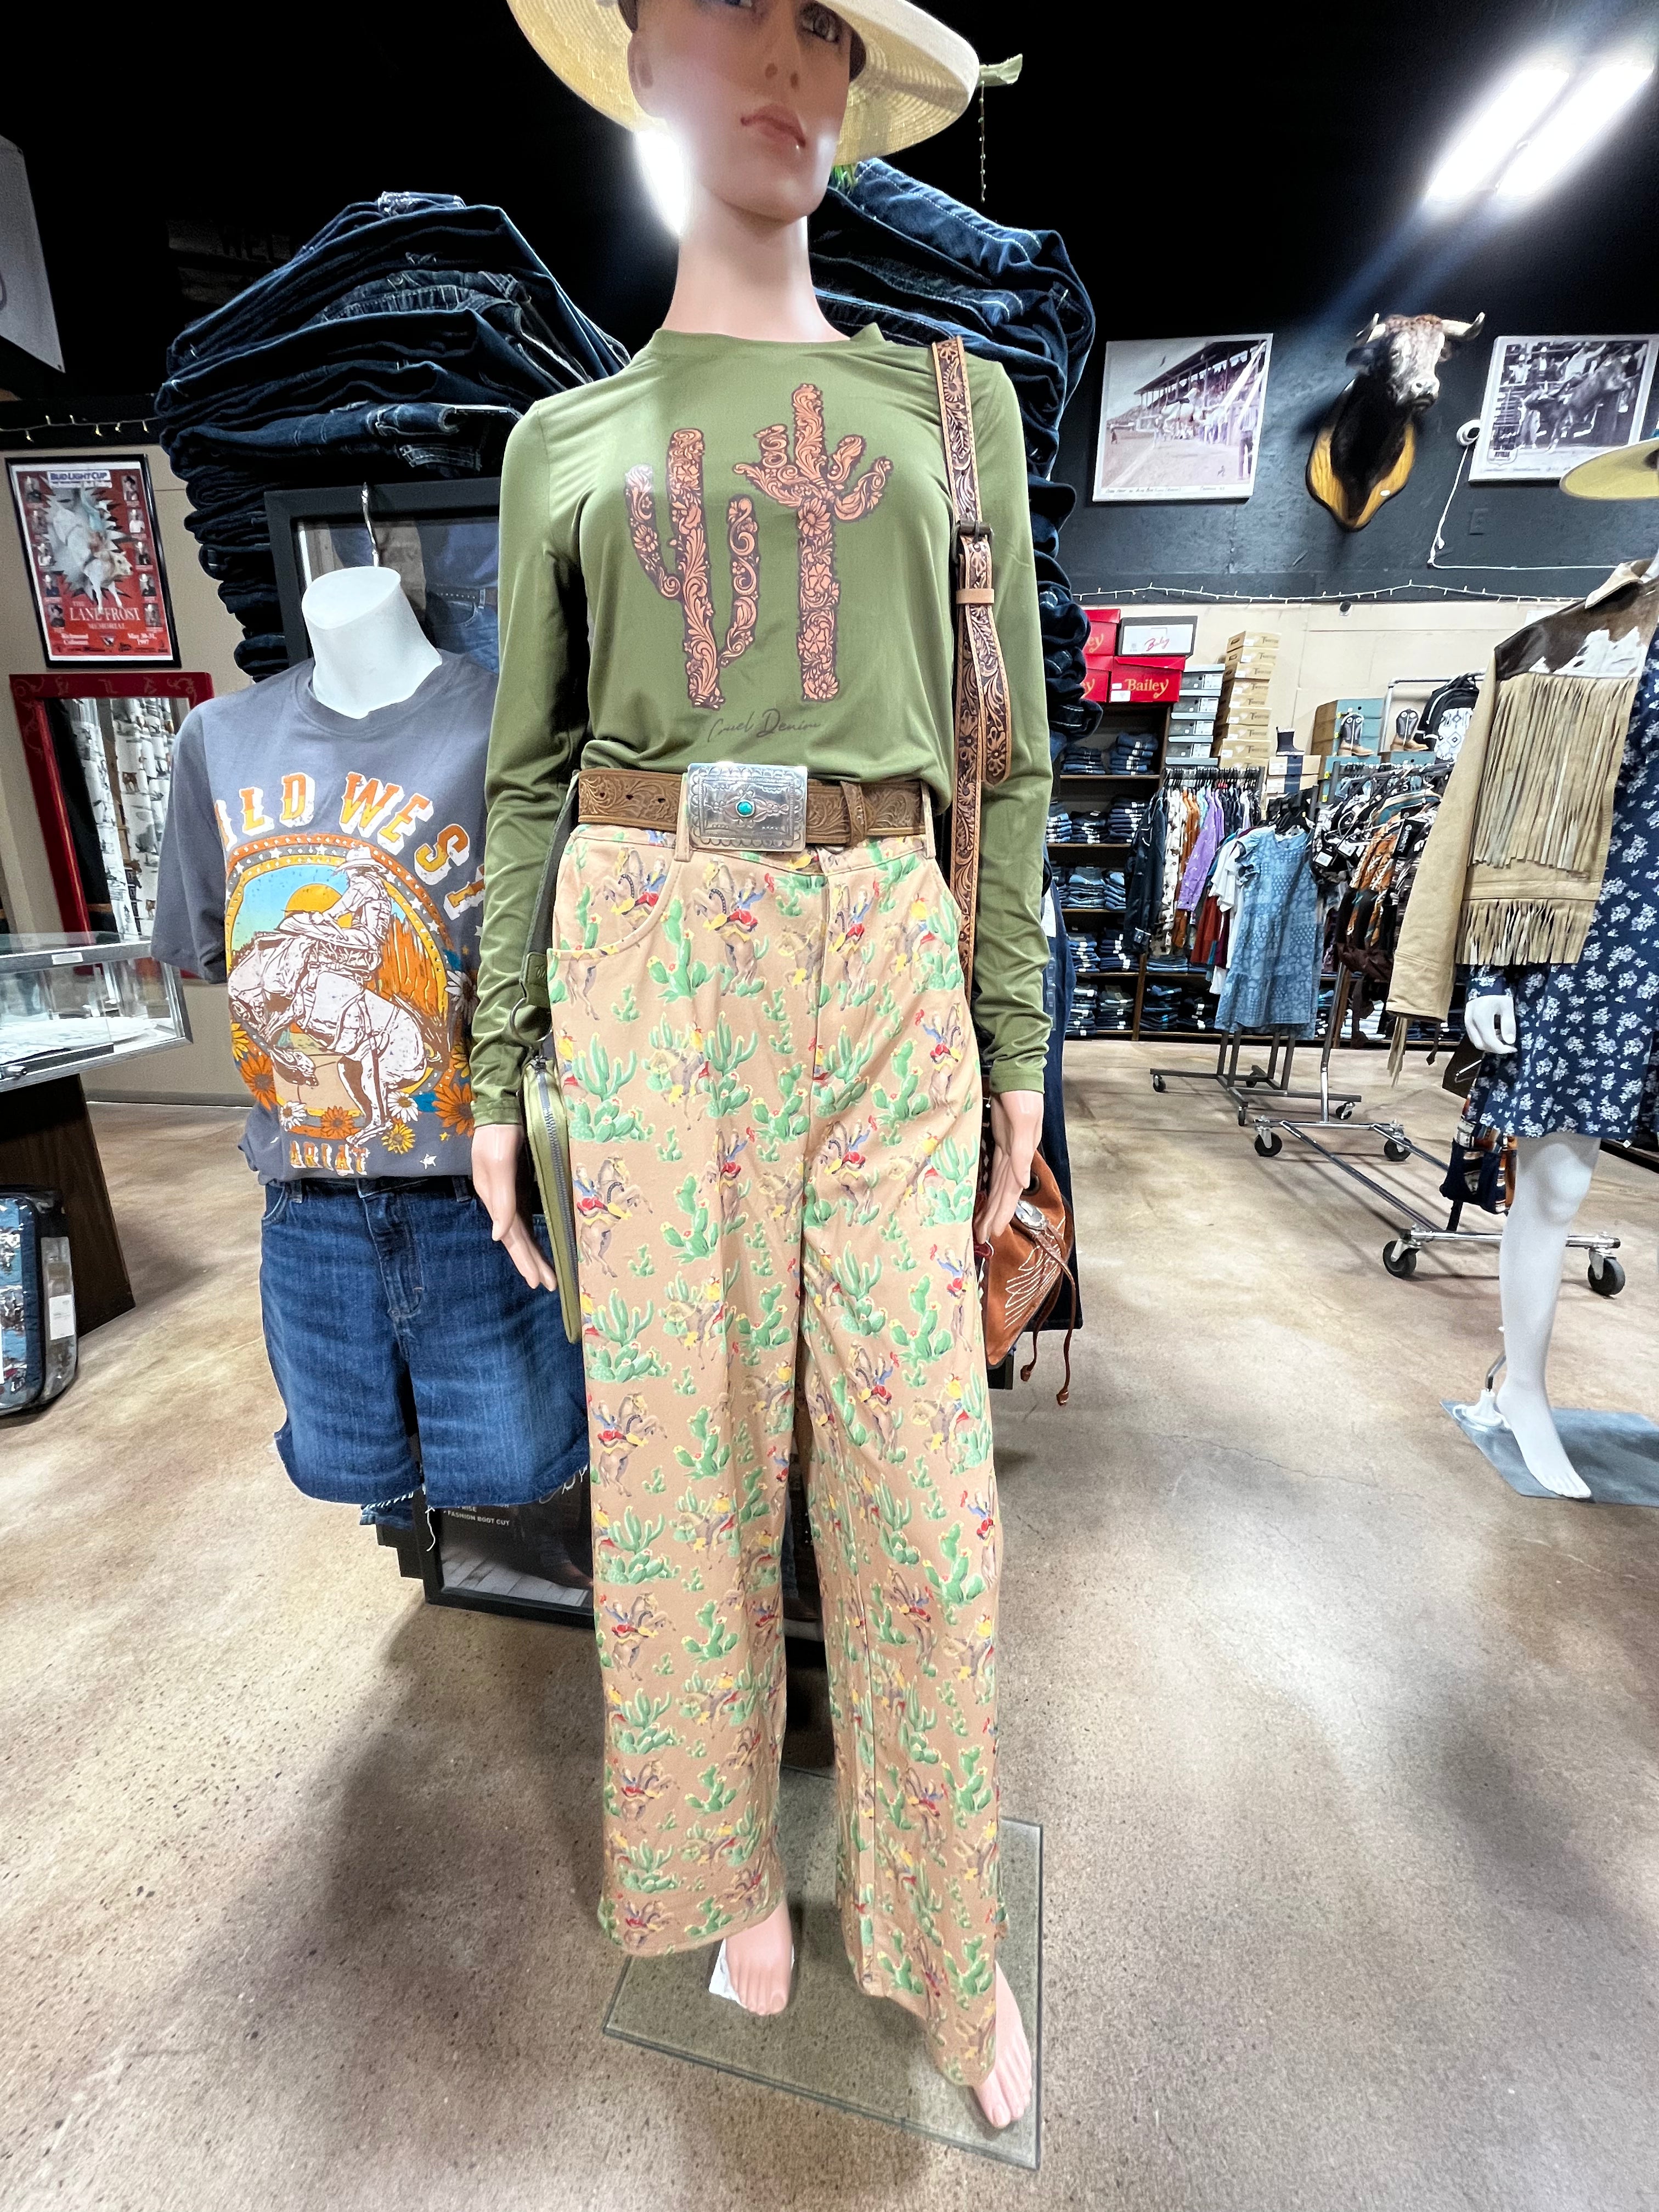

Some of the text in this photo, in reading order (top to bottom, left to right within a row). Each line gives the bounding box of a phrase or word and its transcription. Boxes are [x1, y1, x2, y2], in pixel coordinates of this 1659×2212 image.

[69, 607, 141, 621] LANE FROST
[1125, 678, 1169, 699] Bailey
[756, 708, 821, 738] Denim
[215, 772, 317, 851] LD
[289, 1141, 371, 1177] ARIAT
[448, 1510, 476, 1521] FASHION
[477, 1516, 495, 1524] BOOT
